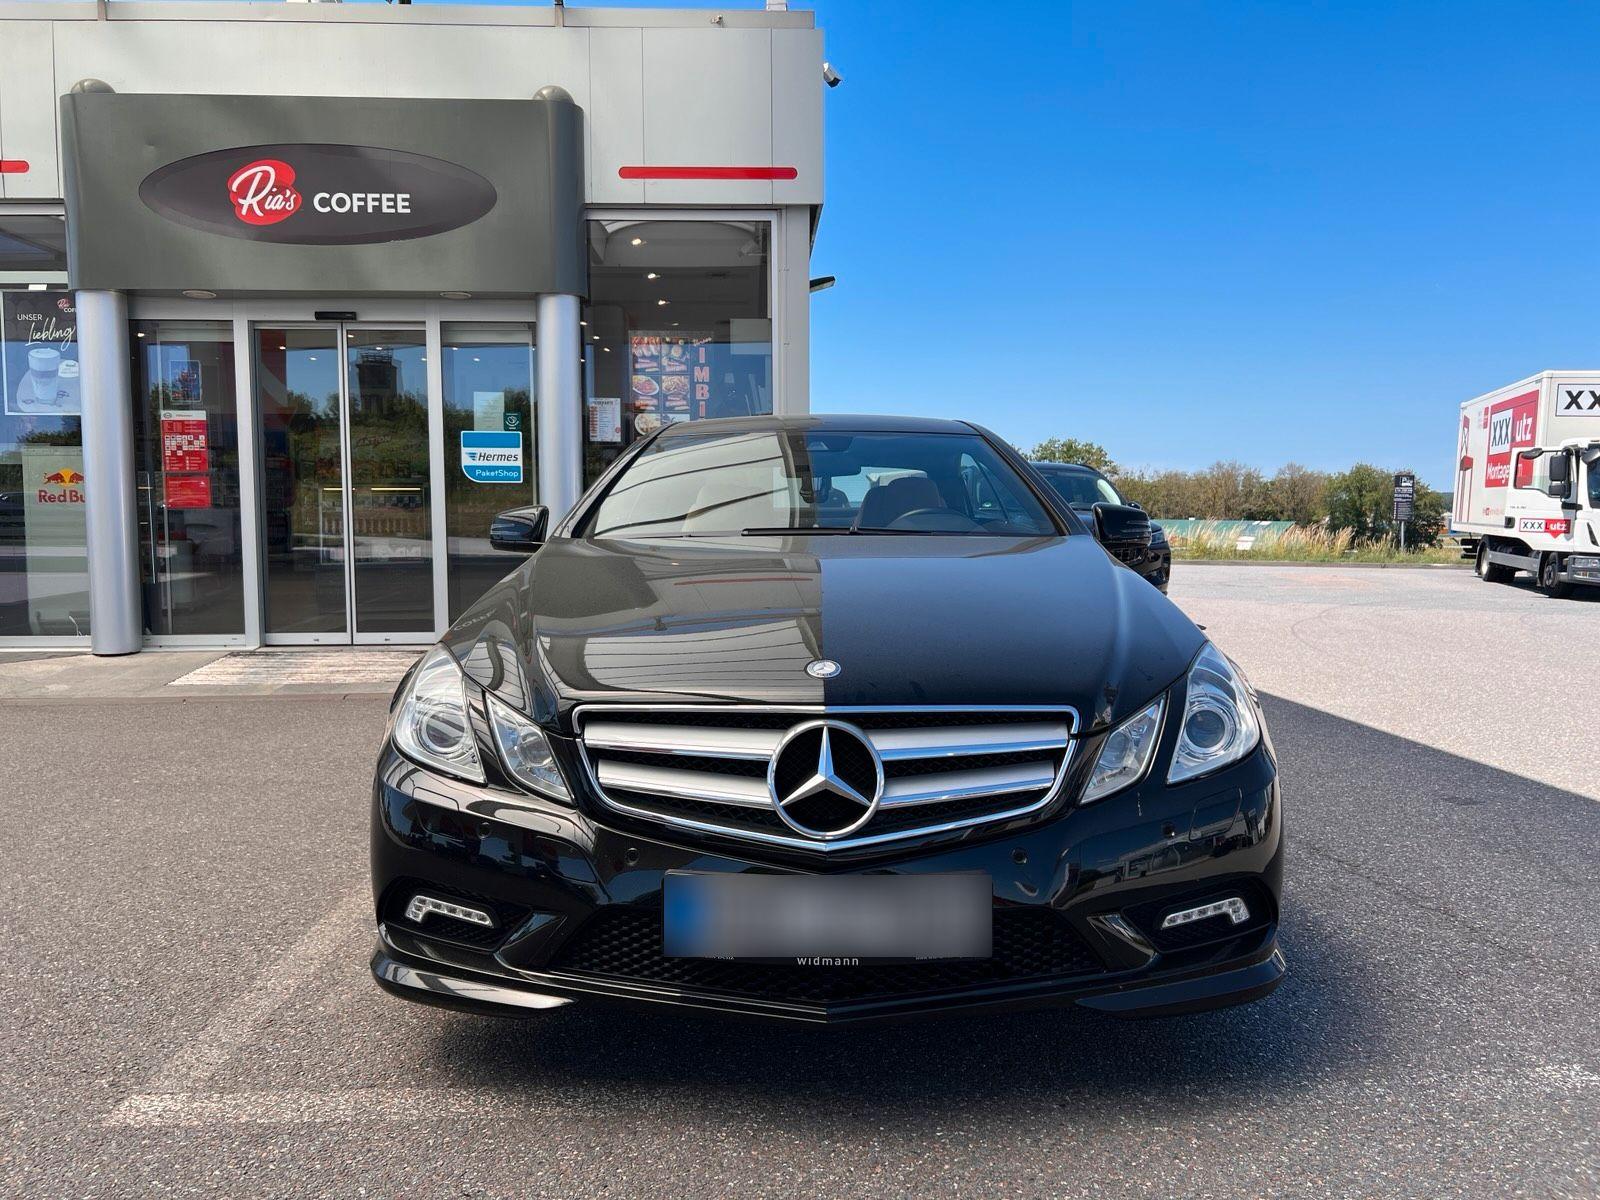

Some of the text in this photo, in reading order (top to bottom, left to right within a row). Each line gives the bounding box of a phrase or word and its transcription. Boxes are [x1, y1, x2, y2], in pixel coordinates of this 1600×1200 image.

[231, 165, 411, 217] Ria's COFFEE
[17, 313, 43, 321] UNSER
[25, 317, 76, 351] Liebling
[693, 347, 710, 420] IMBI
[478, 452, 519, 462] Hermes
[475, 469, 519, 479] PaketShop
[38, 489, 67, 503] Red
[796, 956, 859, 966] widmann
